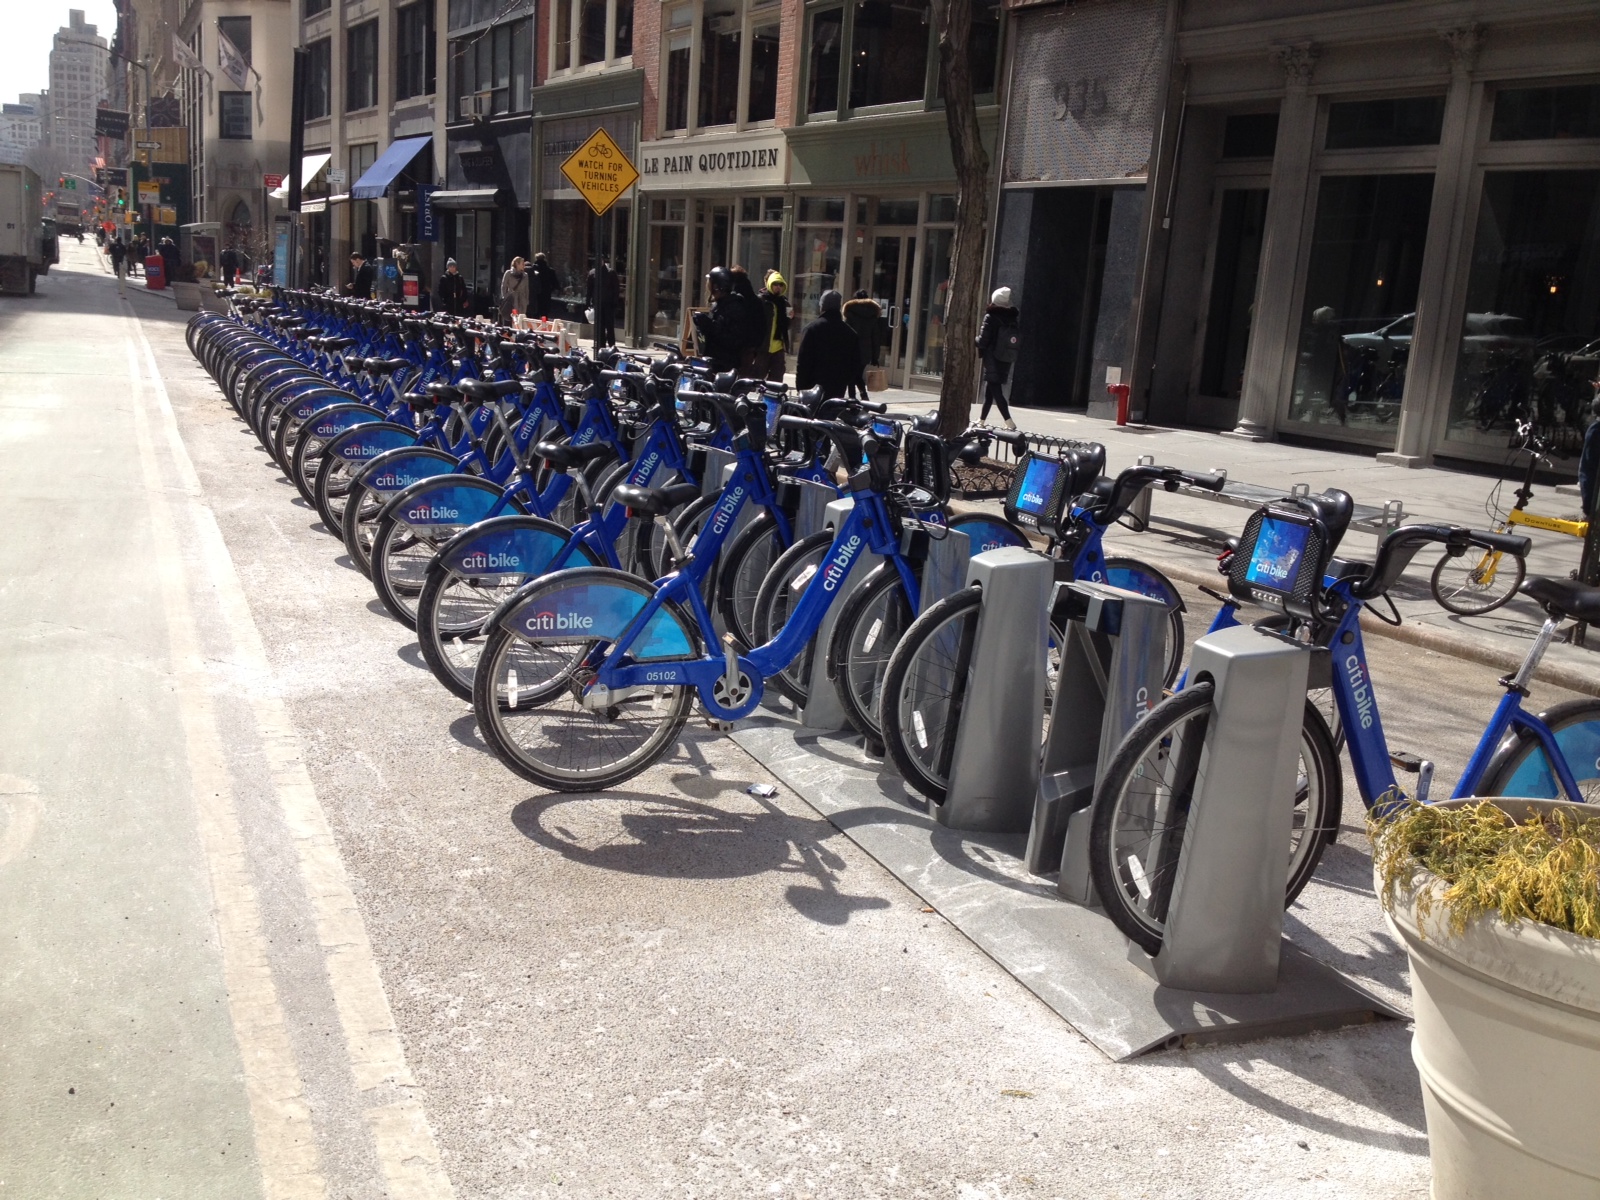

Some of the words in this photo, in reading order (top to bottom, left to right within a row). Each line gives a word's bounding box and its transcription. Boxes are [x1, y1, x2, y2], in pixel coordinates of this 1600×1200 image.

[578, 160, 604, 170] WATCH
[608, 162, 623, 172] FOR
[644, 157, 659, 174] LE
[663, 155, 693, 173] PAIN
[698, 148, 778, 171] QUOTIDIEN
[854, 140, 911, 177] whisk
[584, 170, 618, 182] TURNING
[581, 181, 619, 193] VEHICLES
[424, 190, 432, 236] FLORIST
[479, 407, 490, 422] citi
[520, 423, 533, 440] citi
[529, 407, 542, 427] bike
[317, 423, 332, 434] citi
[344, 444, 361, 456] citi
[639, 452, 659, 476] bike
[375, 474, 394, 486] citi
[408, 505, 430, 519] citi
[431, 507, 459, 519] bike
[713, 511, 729, 534] citi
[721, 486, 744, 515] bike
[462, 552, 487, 568] citi
[488, 553, 520, 567] bike
[823, 564, 843, 591] citi
[833, 535, 861, 568] bike
[1256, 561, 1270, 574] citi
[1269, 565, 1288, 578] bike
[525, 611, 554, 630] citi
[556, 613, 593, 629] bike
[646, 671, 676, 681] 05102
[1345, 655, 1367, 688] citi
[1136, 687, 1150, 719] cit
[1354, 684, 1373, 729] bike
